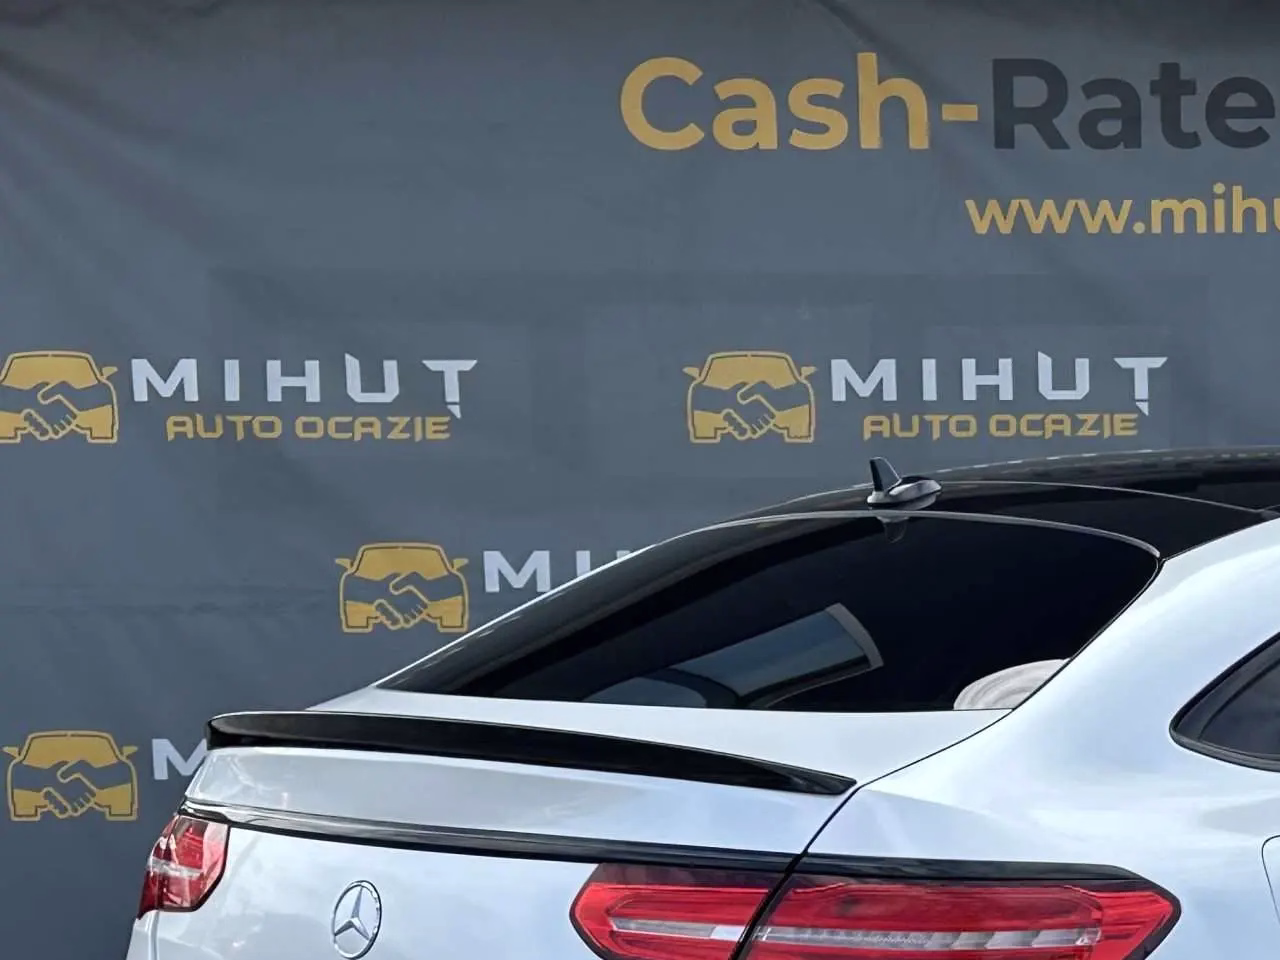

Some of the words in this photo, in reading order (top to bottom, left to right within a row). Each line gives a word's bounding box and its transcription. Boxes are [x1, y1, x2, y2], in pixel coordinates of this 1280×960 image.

[166, 415, 283, 442] AUTO
[295, 414, 452, 441] OCAZIE
[863, 413, 978, 441] AUTO
[989, 412, 1140, 439] OCAZIE
